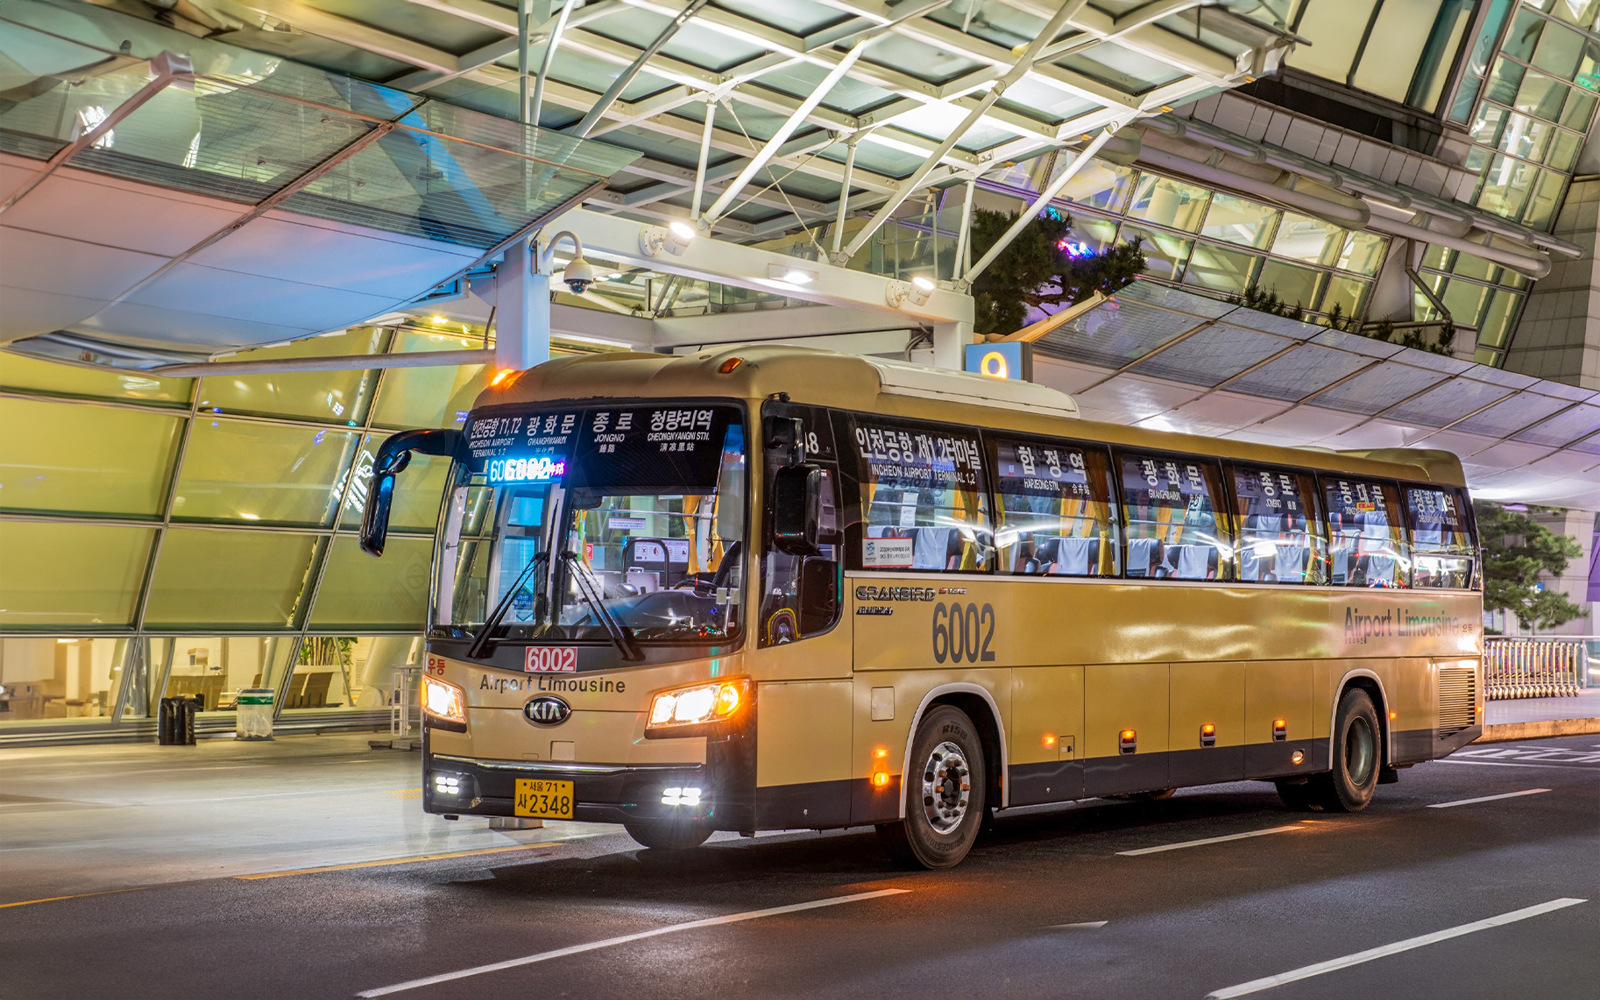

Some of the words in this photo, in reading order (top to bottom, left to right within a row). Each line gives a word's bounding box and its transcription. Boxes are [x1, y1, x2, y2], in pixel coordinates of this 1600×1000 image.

[471, 418, 500, 438] 인천공항
[499, 417, 522, 436] T1,T2
[651, 410, 714, 431] 청량리역
[469, 439, 492, 449] INCHEON
[491, 438, 515, 447] AIRPORT
[594, 433, 625, 443] JONGNO
[647, 432, 696, 442] CHEONGNYANGNI
[855, 427, 914, 463] 인천공항
[871, 464, 903, 477] INCHEON
[904, 466, 932, 480] AIRPORT
[934, 469, 966, 482] TERMINAL
[856, 586, 936, 601] GRANBIRD
[932, 602, 995, 663] 6002
[1344, 606, 1392, 644] Airport
[1397, 608, 1459, 637] Limousine
[428, 658, 445, 676] 우등
[528, 648, 575, 672] 6002
[480, 674, 532, 694] Airport
[538, 675, 626, 693] Limousine
[529, 703, 562, 720] KIA
[530, 781, 543, 792] 서울
[546, 782, 557, 792] 71
[922, 829, 966, 852] BRIDGESTONE
